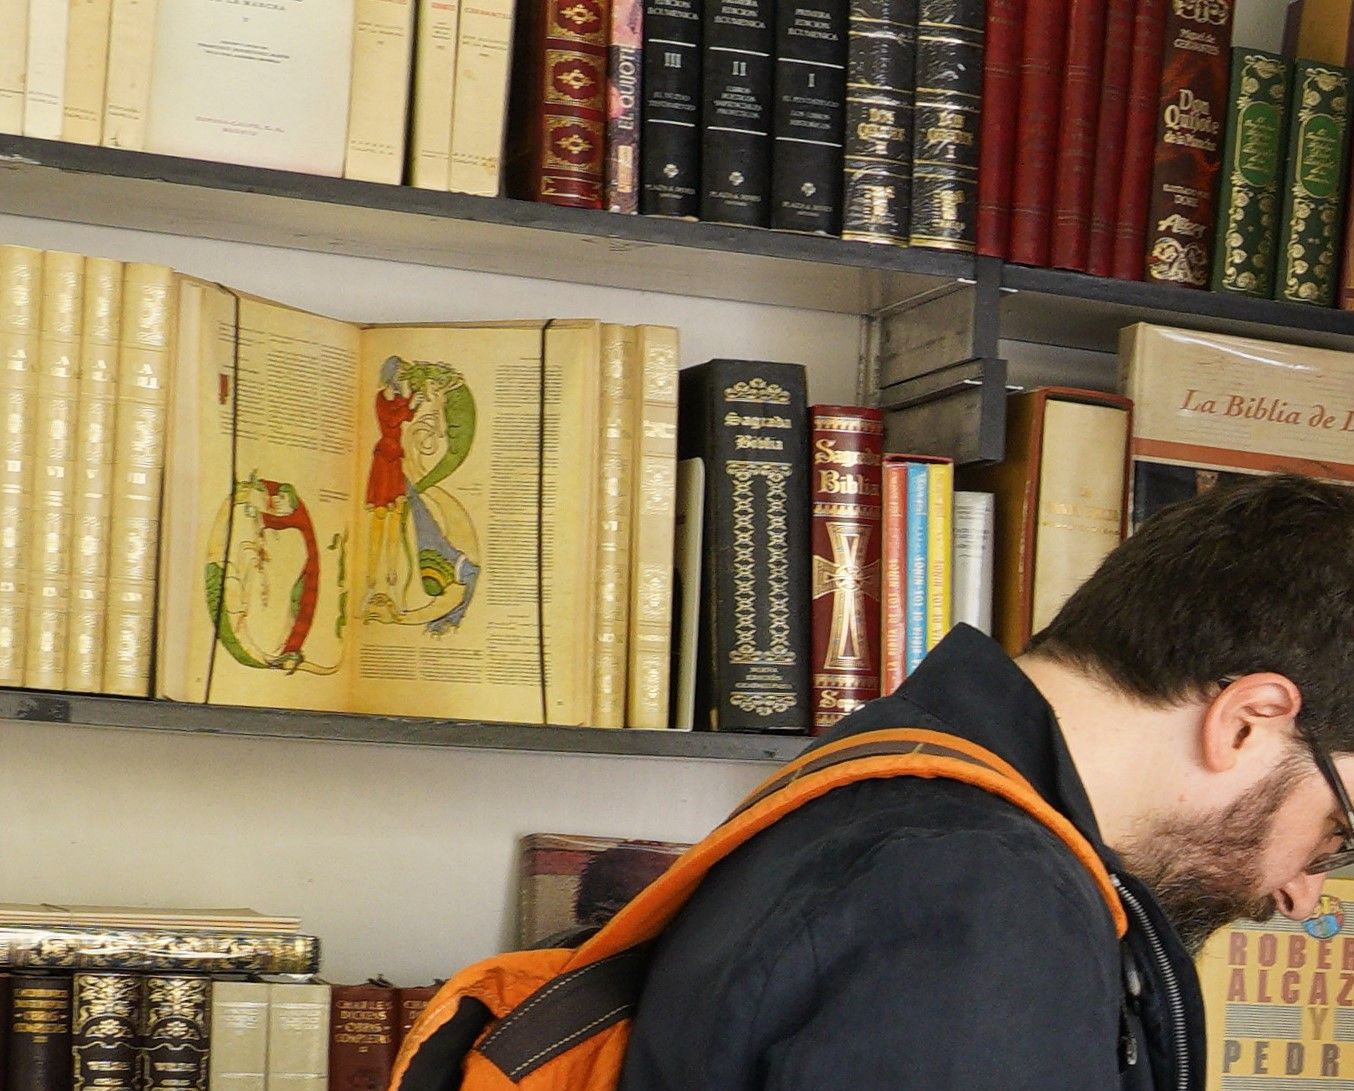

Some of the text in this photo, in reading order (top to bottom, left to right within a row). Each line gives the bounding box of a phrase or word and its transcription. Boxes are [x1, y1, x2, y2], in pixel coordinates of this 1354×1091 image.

[1179, 89, 1210, 115] Don
[1180, 389, 1217, 414] La
[1224, 394, 1301, 425] Biblia
[1309, 404, 1336, 429] de
[819, 469, 880, 496] Biblia
[1307, 1006, 1329, 1040] Y
